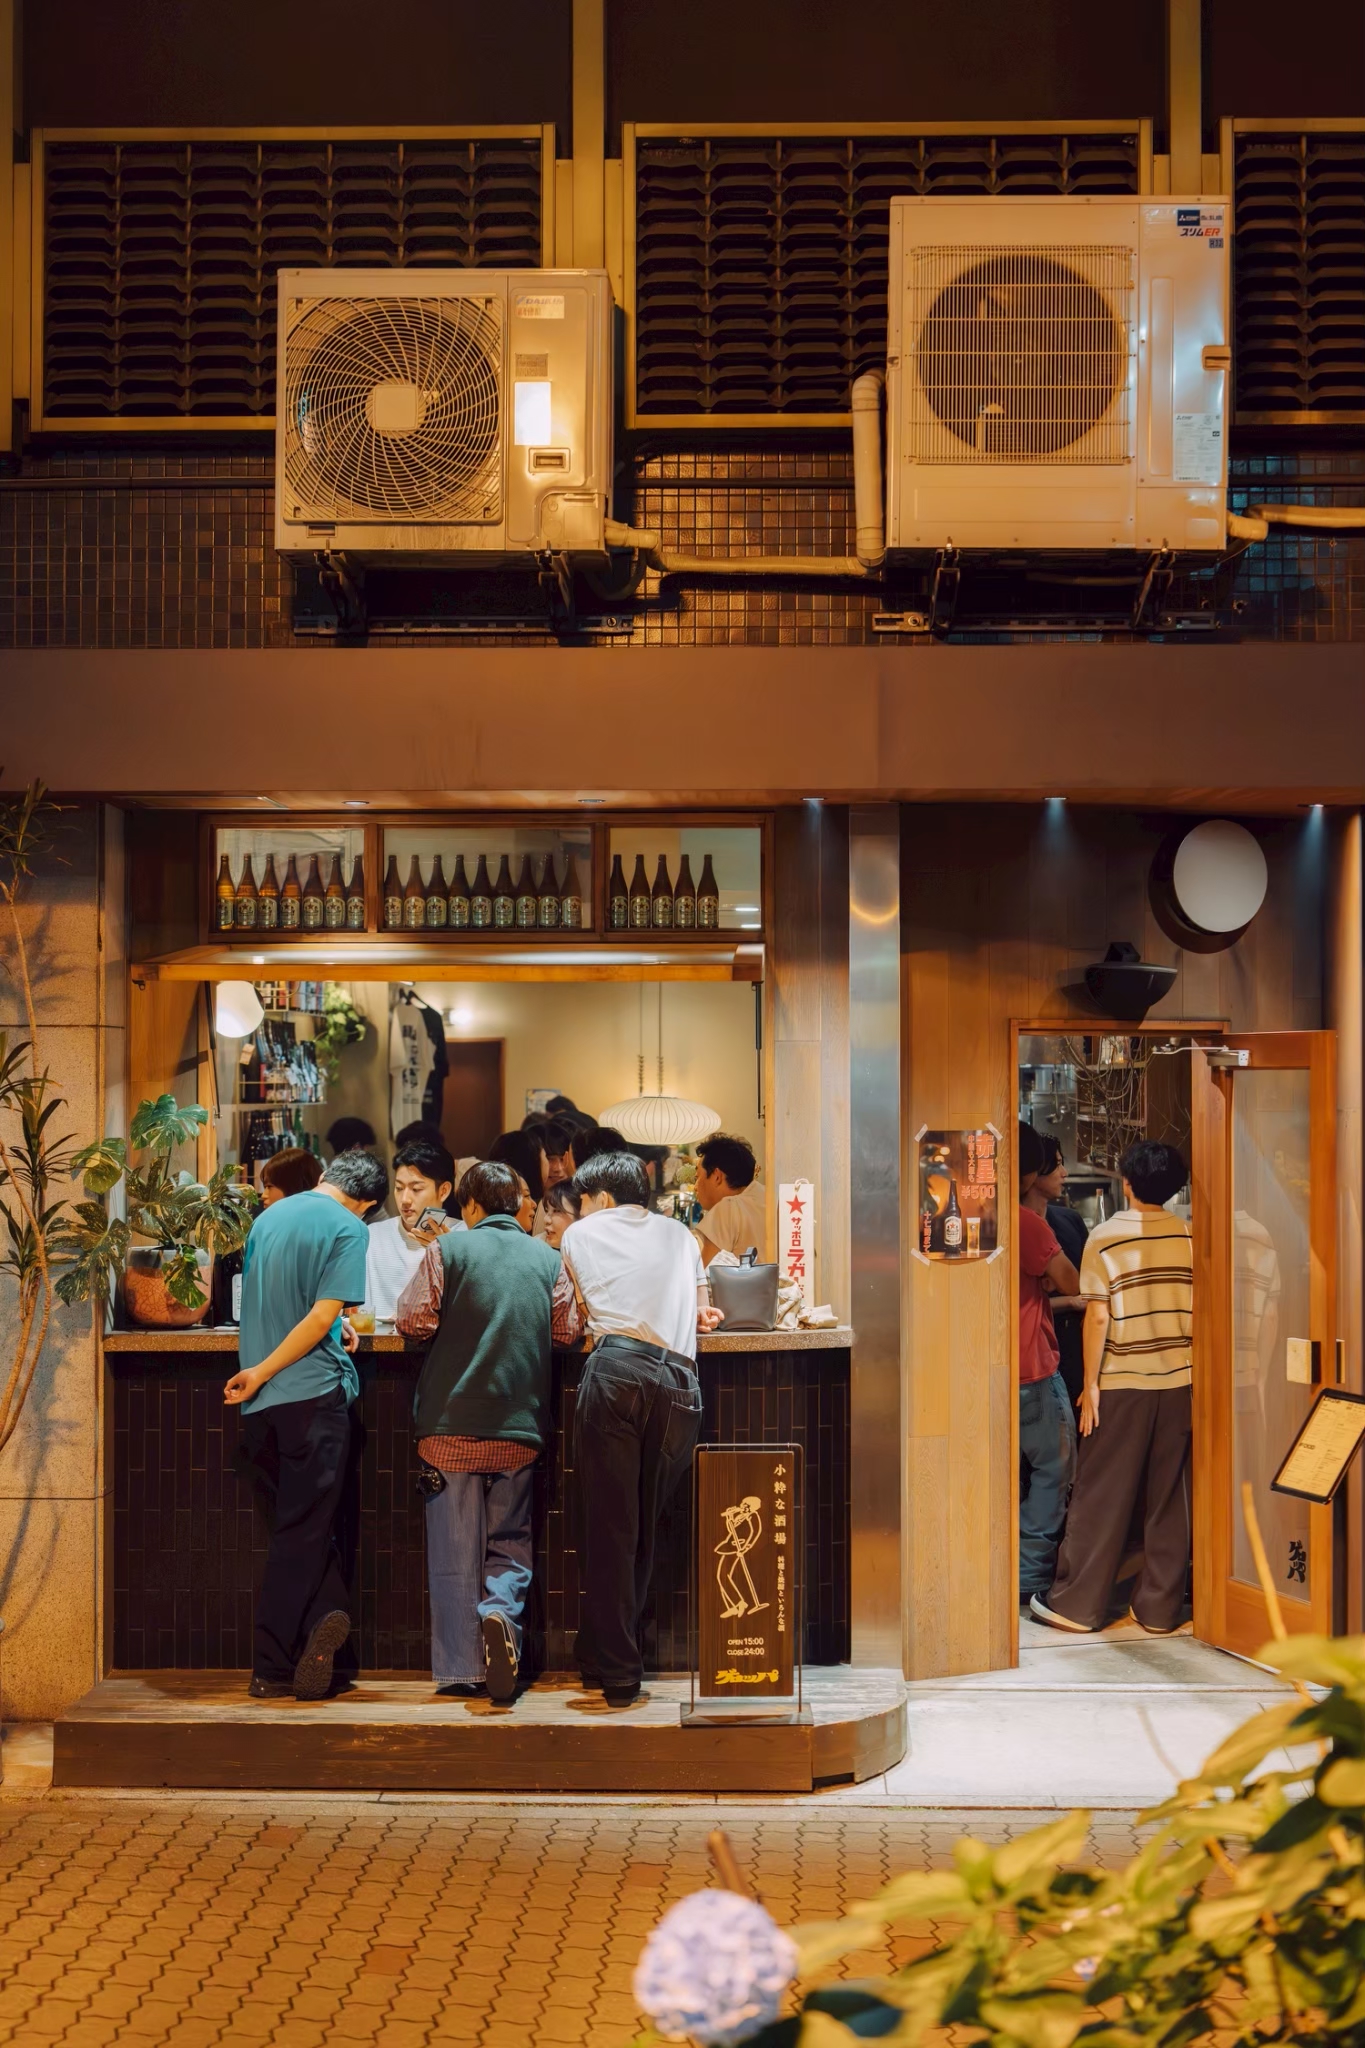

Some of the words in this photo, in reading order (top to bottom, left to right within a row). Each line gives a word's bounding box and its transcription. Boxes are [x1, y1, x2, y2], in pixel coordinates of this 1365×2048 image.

[1180, 227, 1220, 237] スリムER
[975, 1133, 996, 1184] 赤星
[960, 1184, 996, 1200] ¥500
[773, 1463, 787, 1546] 小粋な酒場
[743, 1637, 764, 1646] 15:00
[744, 1647, 765, 1656] 24:00
